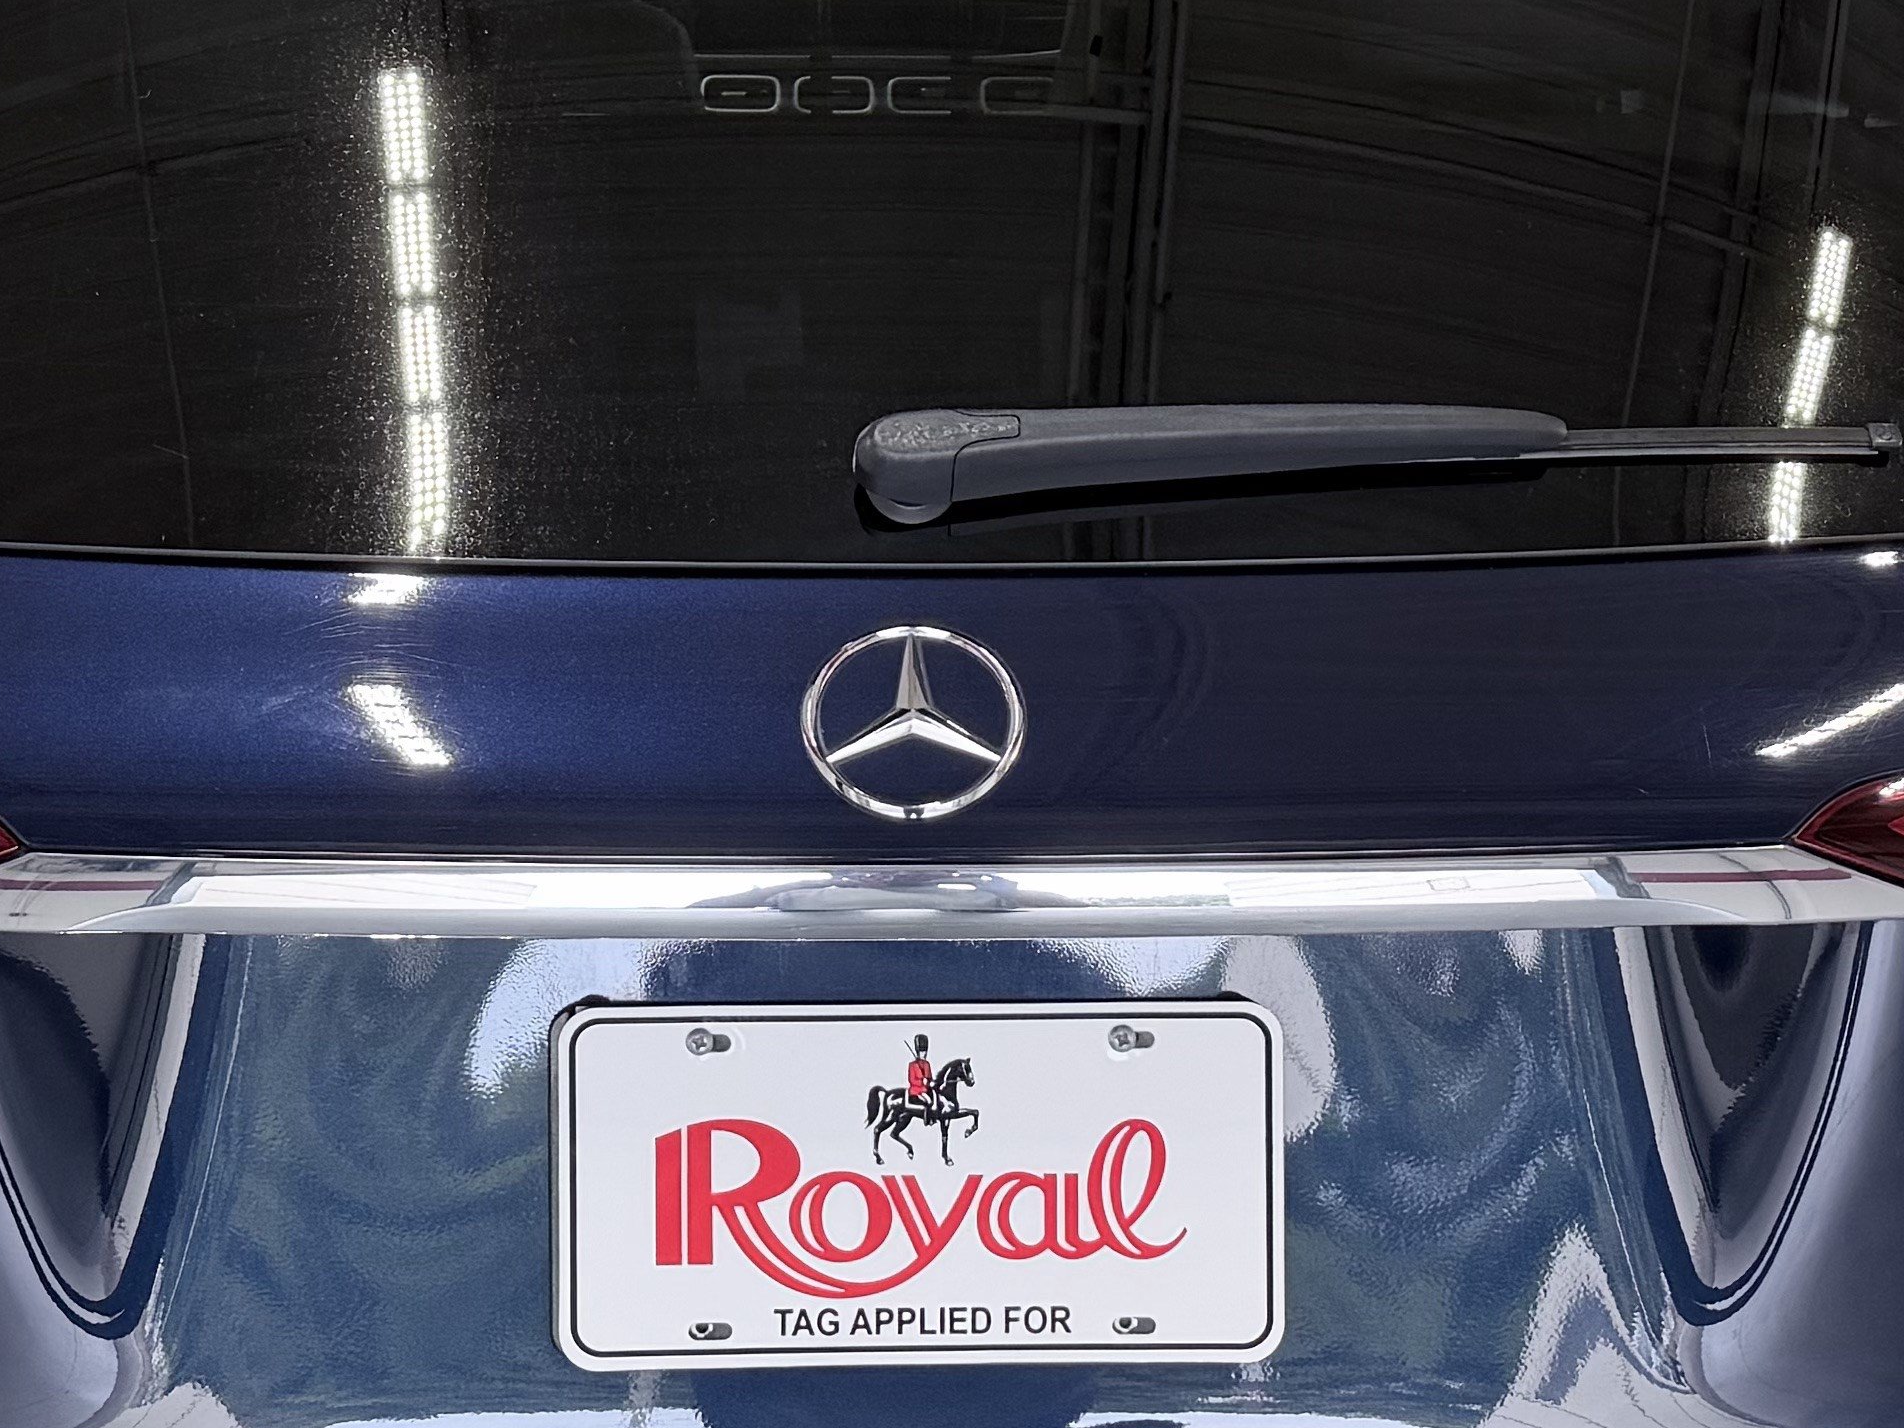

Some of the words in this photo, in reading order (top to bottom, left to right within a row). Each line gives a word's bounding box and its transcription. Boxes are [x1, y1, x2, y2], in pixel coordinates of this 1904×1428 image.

[655, 1117, 1187, 1300] Royal
[773, 1306, 840, 1337] TAG
[849, 1305, 993, 1336] APPLIED
[1003, 1304, 1072, 1335] FOR
